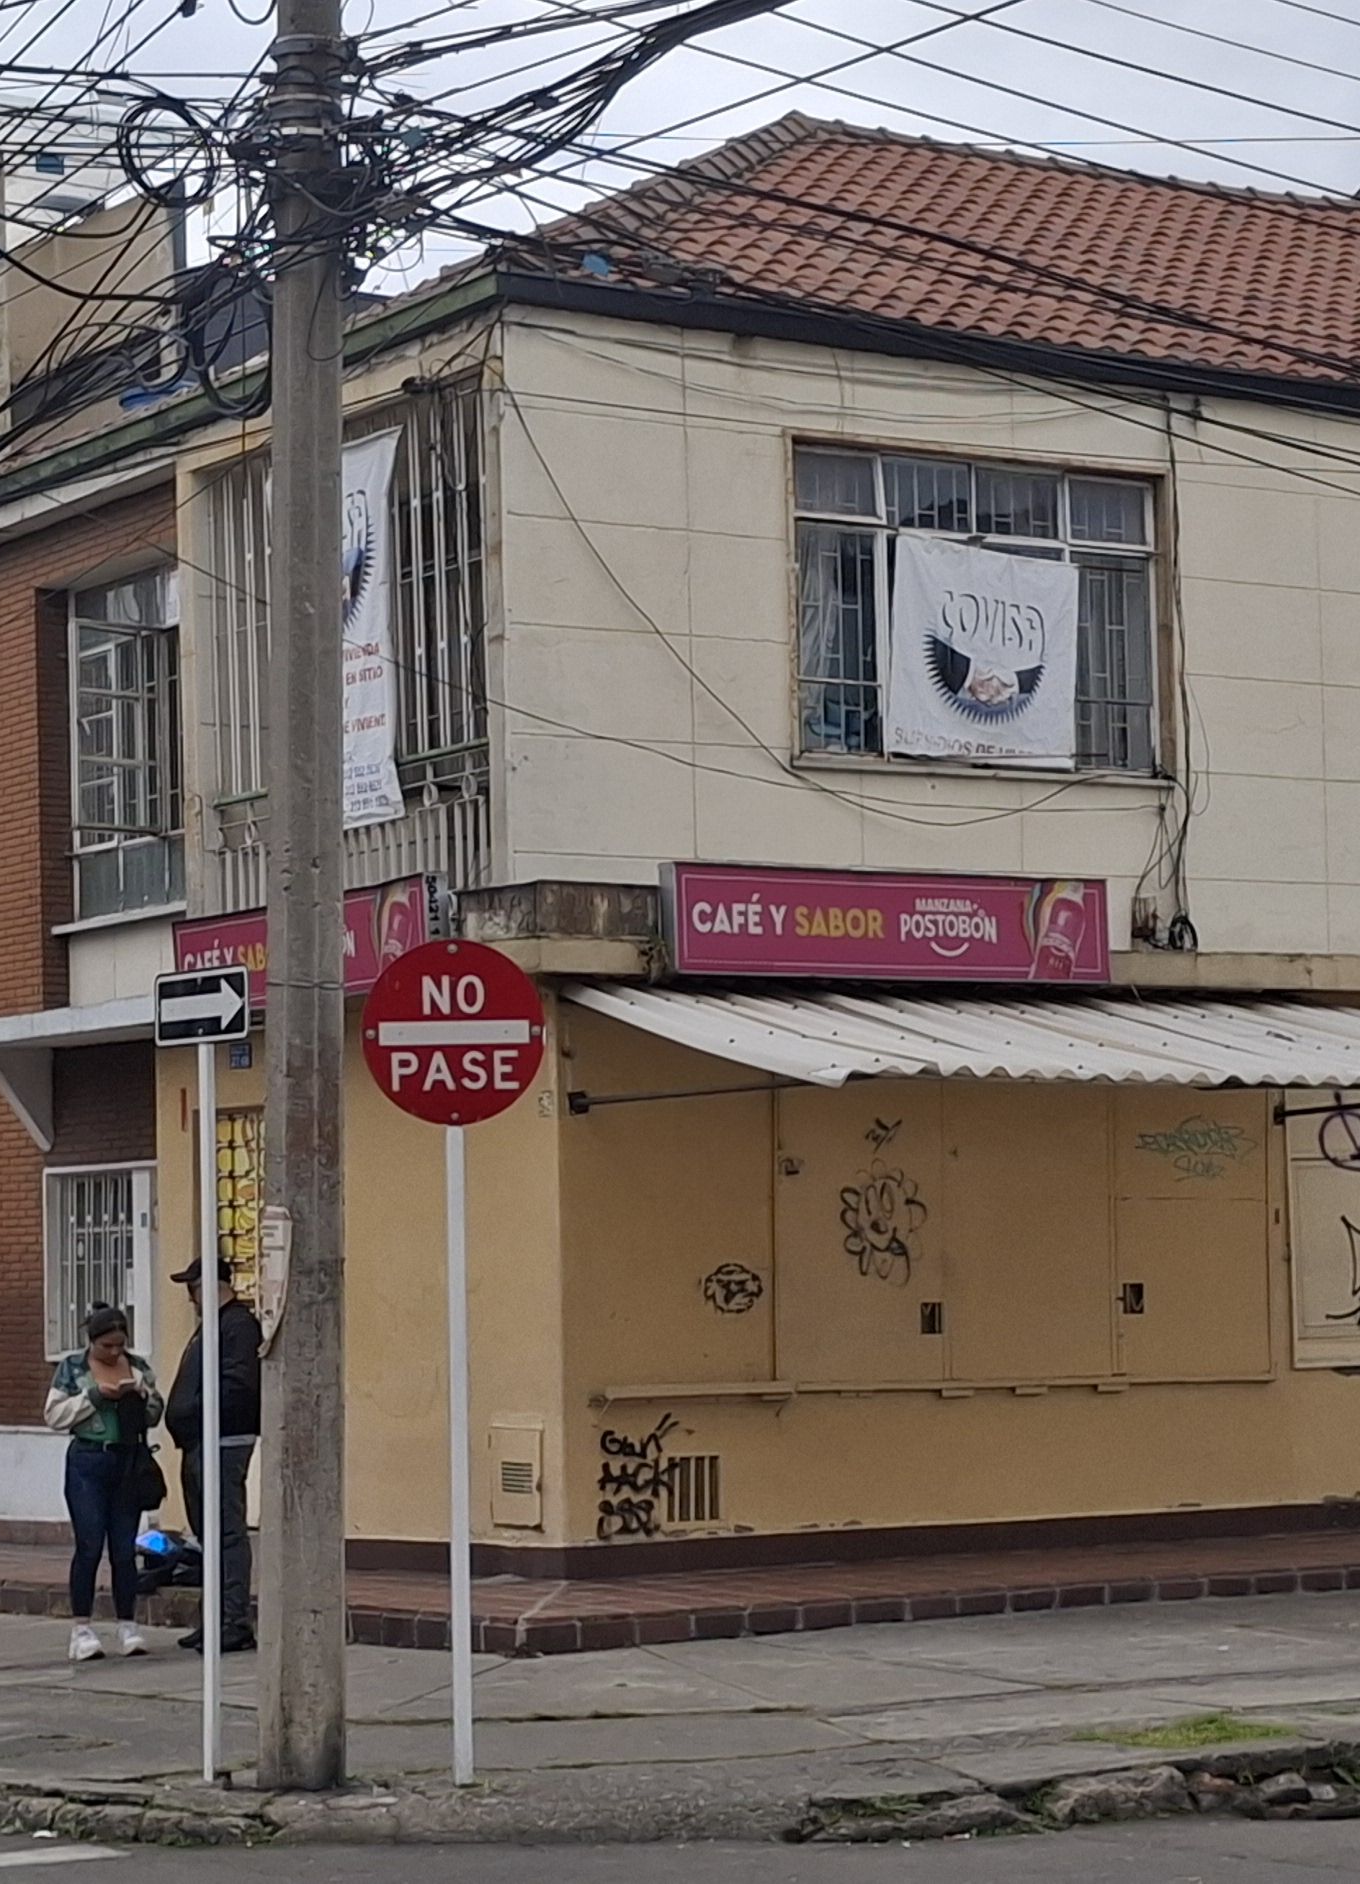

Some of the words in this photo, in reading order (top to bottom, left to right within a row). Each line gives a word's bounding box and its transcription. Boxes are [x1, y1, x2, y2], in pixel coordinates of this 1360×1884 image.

[691, 893, 763, 935] CAFÉ
[769, 904, 788, 936] Y
[794, 906, 885, 939] SABOR
[915, 897, 974, 912] MANZANA
[237, 941, 267, 972] SAB
[421, 974, 485, 1016] NO
[390, 1050, 520, 1092] PASE
